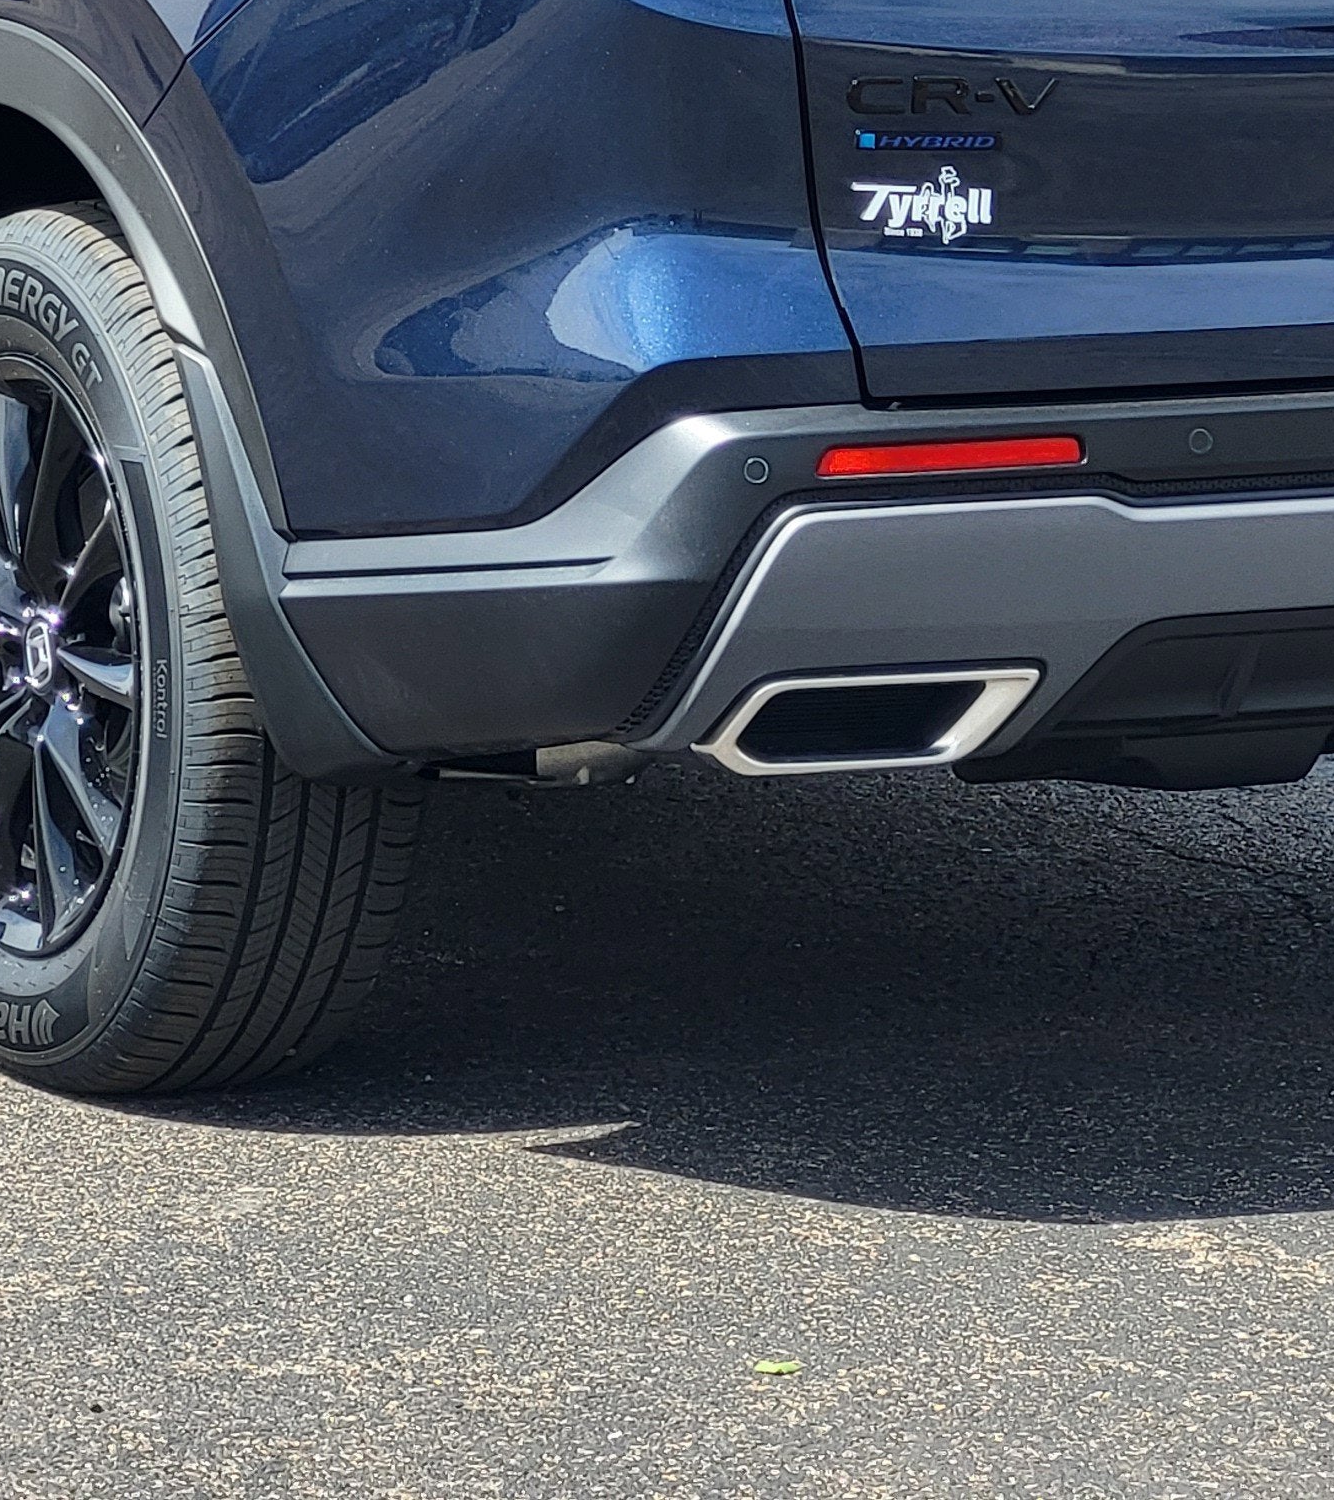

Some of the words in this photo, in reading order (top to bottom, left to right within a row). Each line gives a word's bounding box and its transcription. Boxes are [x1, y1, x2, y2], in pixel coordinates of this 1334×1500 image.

[847, 75, 1059, 116] CR-V
[879, 135, 996, 149] HYBRID
[850, 181, 993, 228] Tyrrell
[71, 342, 103, 391] GT
[156, 659, 168, 739] Kontrol
